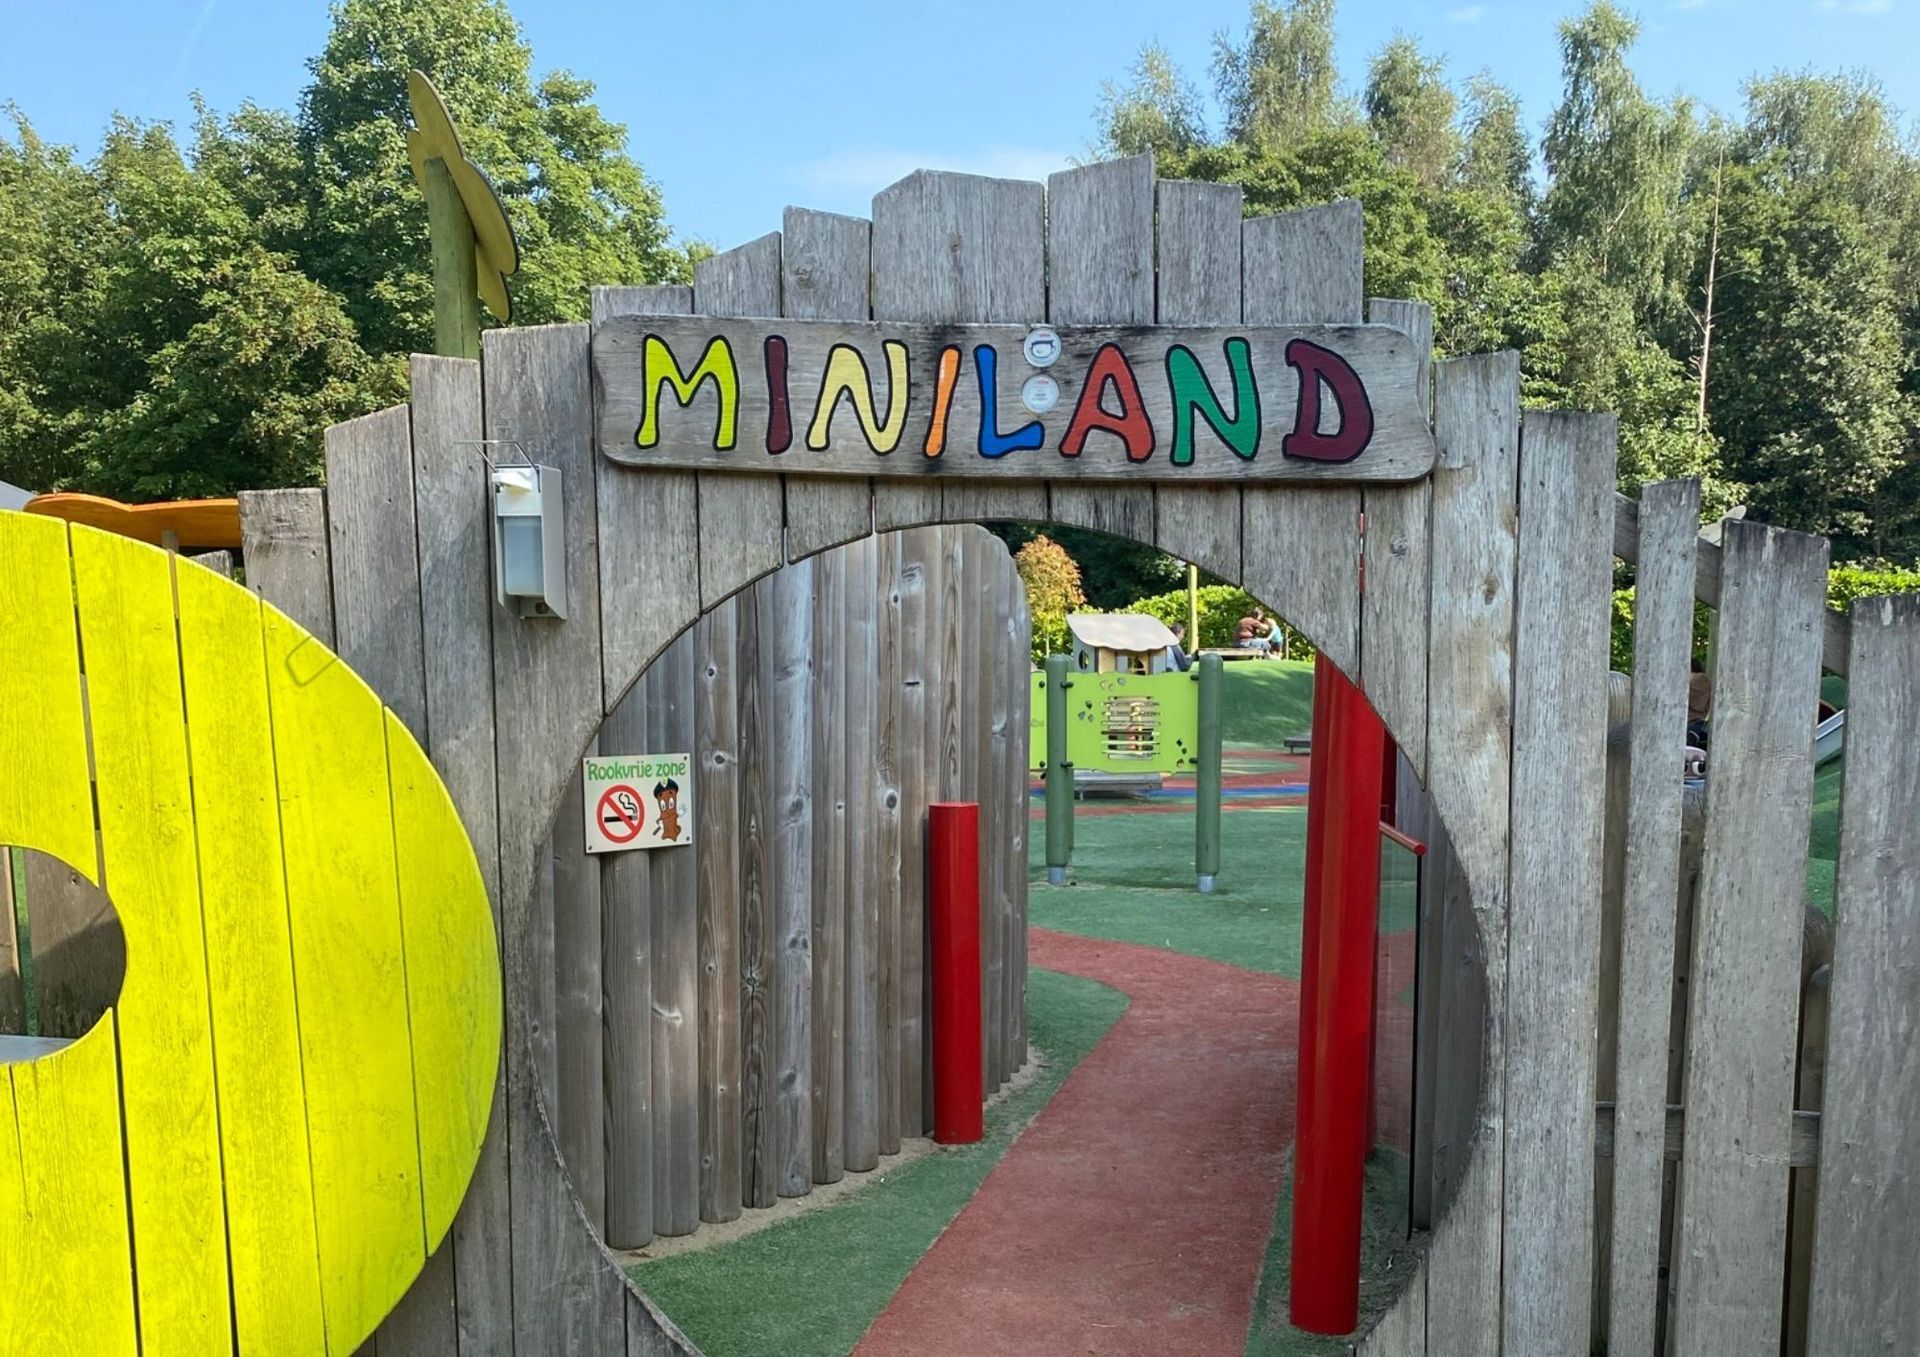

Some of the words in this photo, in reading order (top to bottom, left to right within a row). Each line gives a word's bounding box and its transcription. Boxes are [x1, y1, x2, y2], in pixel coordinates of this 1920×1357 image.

[635, 334, 1374, 466] MINILAND
[588, 761, 653, 780] Rookvrije
[656, 762, 686, 777] zone
